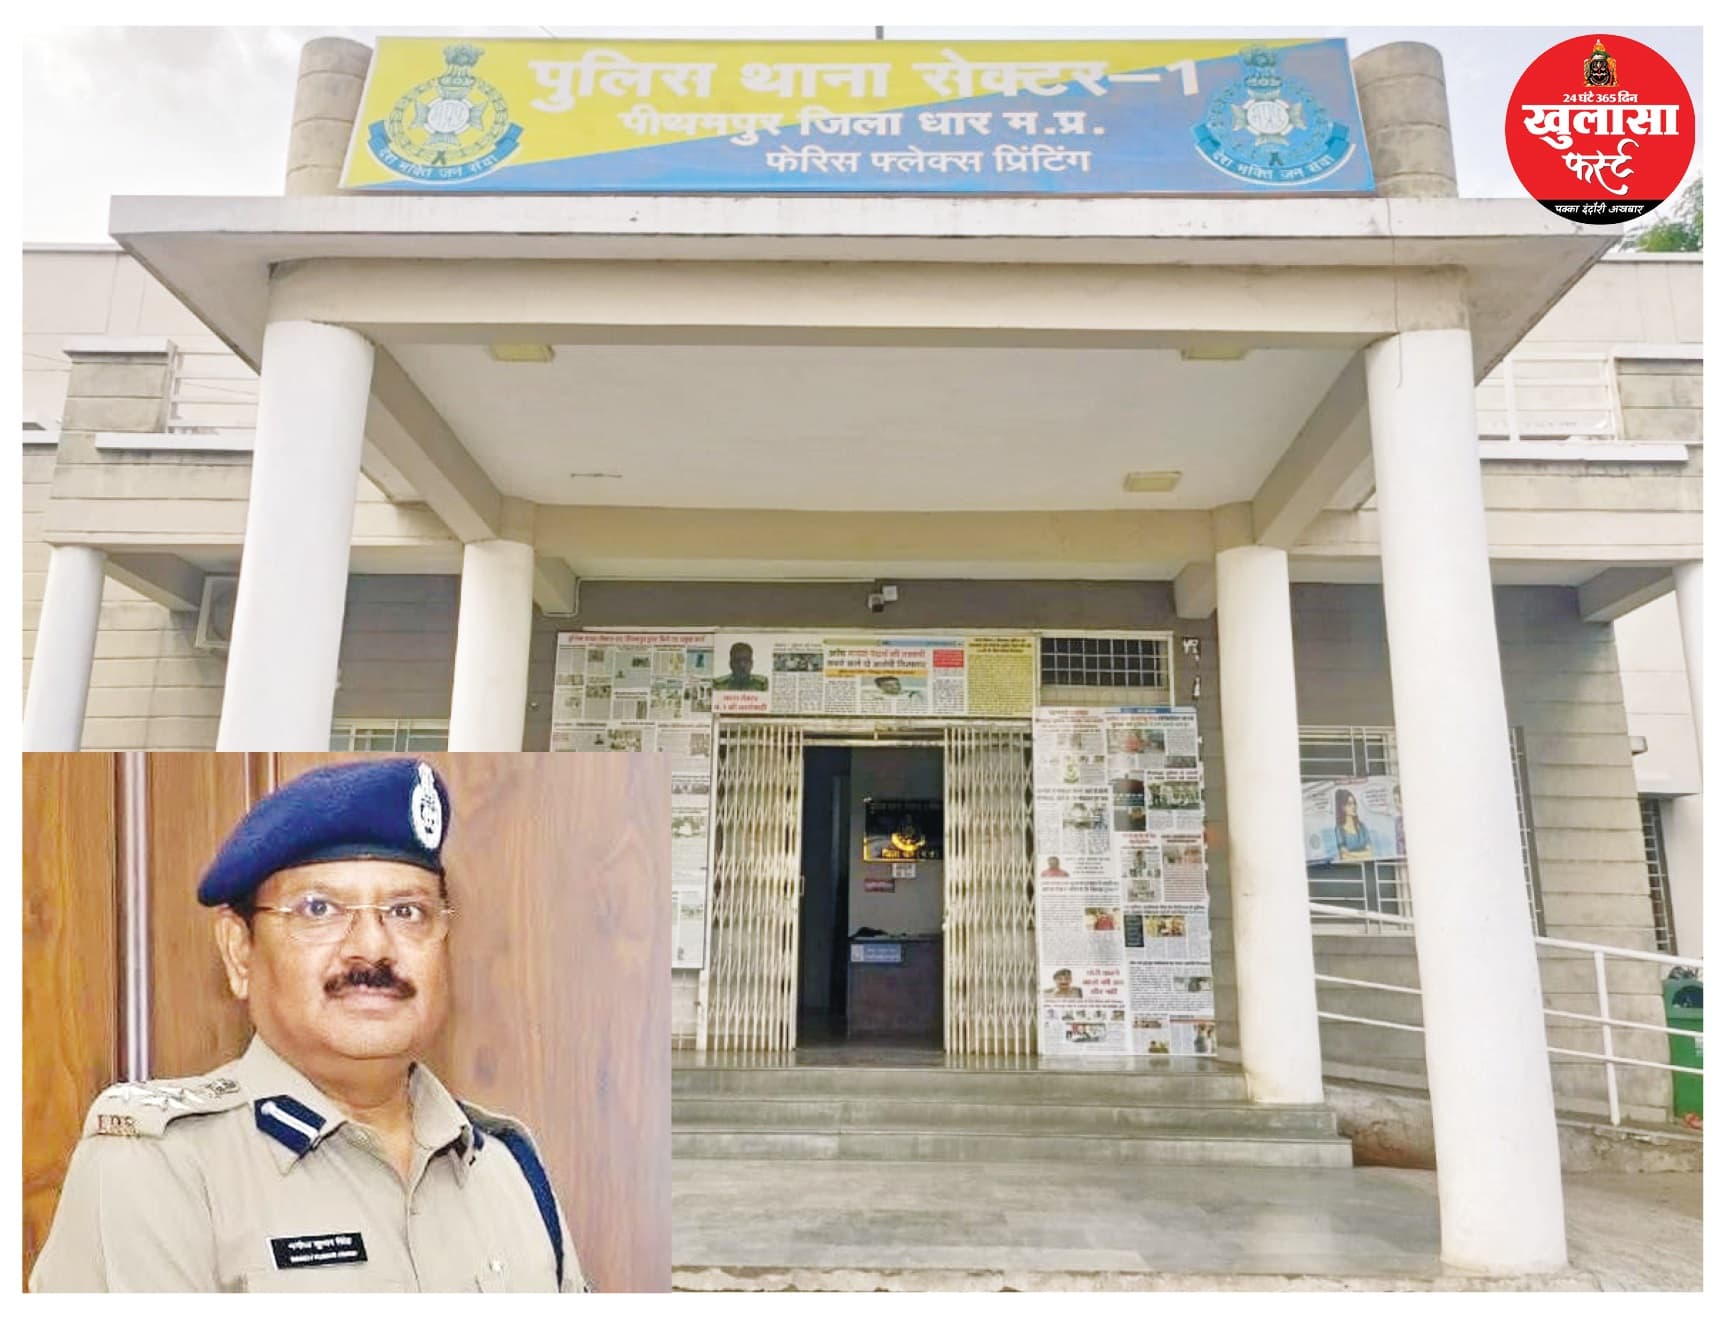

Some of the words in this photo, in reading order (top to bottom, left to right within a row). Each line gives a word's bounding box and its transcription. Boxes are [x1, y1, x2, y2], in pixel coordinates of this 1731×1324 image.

[529, 50, 717, 112] पुलिस
[740, 59, 886, 99] थाना
[619, 105, 781, 146] पीथमपुर
[800, 107, 899, 136] जिला
[919, 110, 989, 136] धार
[1005, 109, 1104, 136] म.प्र.
[767, 145, 859, 174] फेरिस
[872, 144, 982, 175] फ्लेक्स
[995, 143, 1092, 174] प्रिंटिंग
